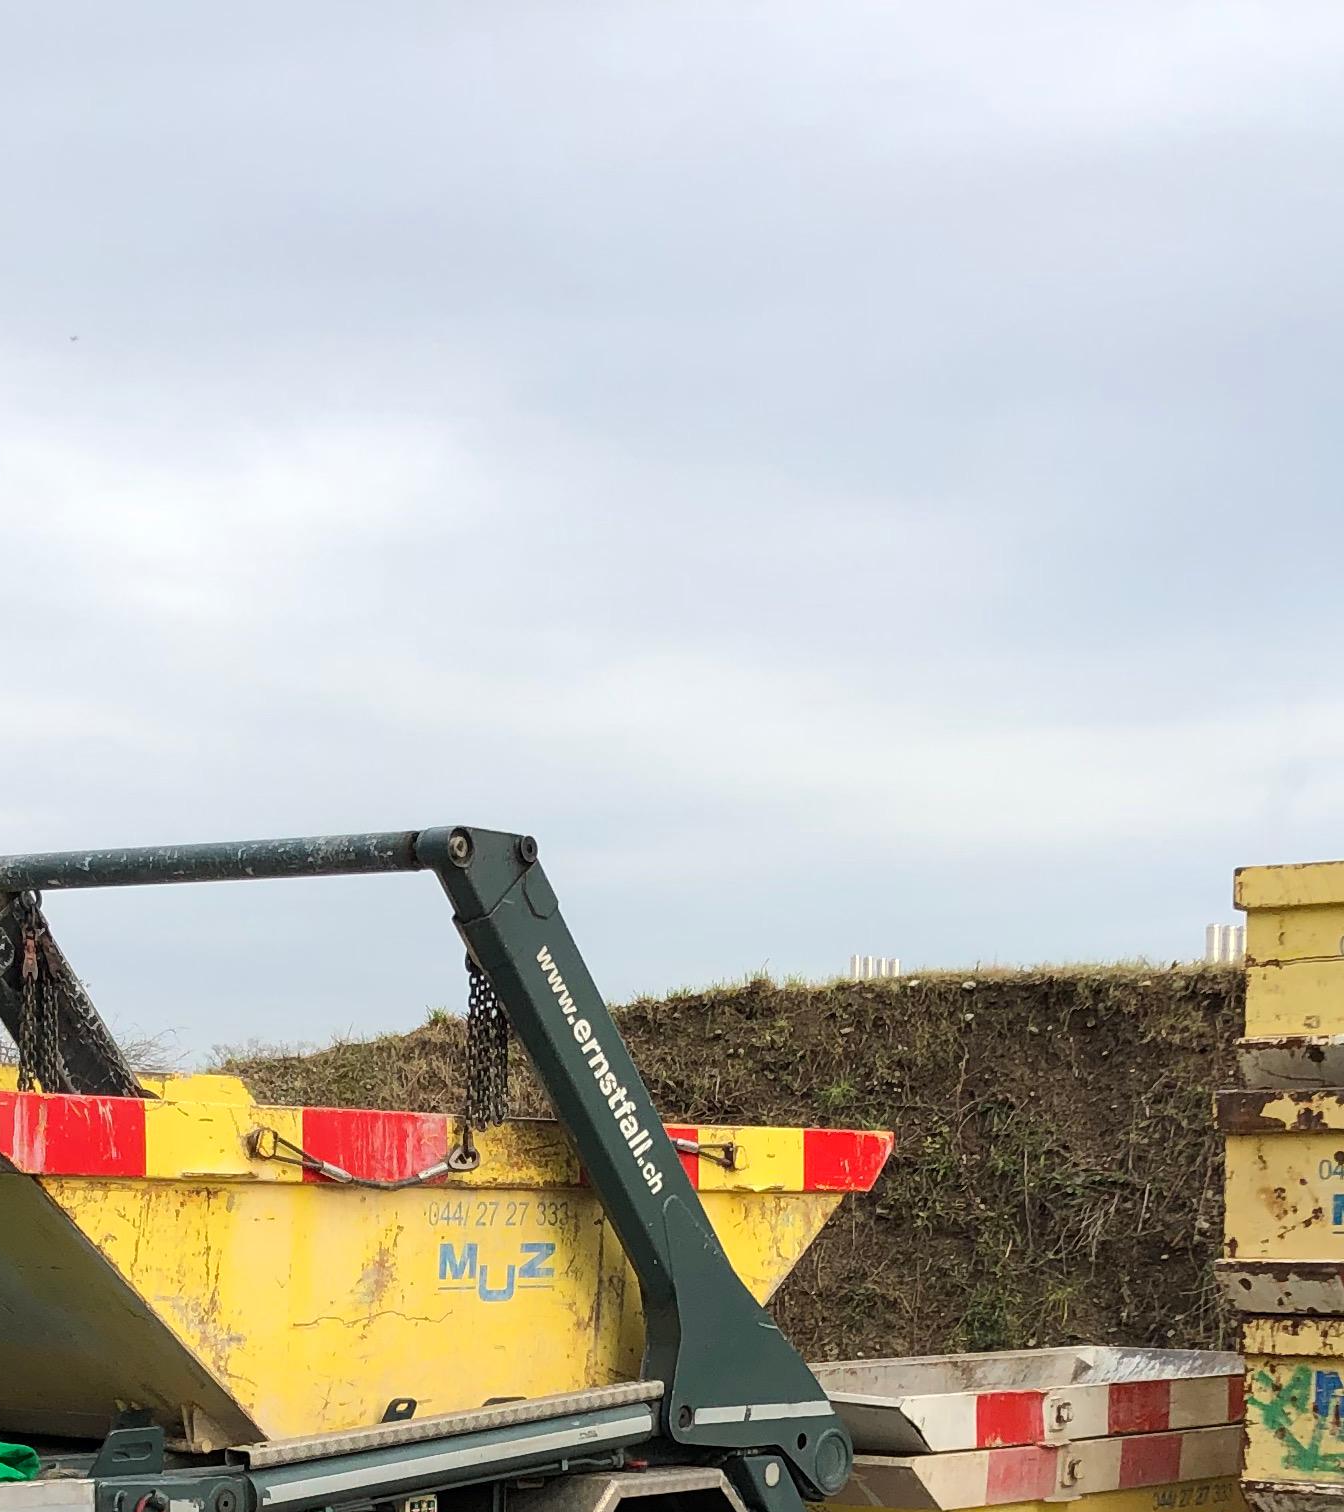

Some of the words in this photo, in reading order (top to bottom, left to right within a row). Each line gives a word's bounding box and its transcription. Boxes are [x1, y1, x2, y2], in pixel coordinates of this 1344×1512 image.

[536, 945, 663, 1195] www.ernstfall.ch
[428, 1201, 470, 1227] 044/
[475, 1200, 501, 1227] 27
[505, 1200, 530, 1227] 27
[535, 1200, 570, 1227] 333
[438, 1242, 556, 1302] MUZ
